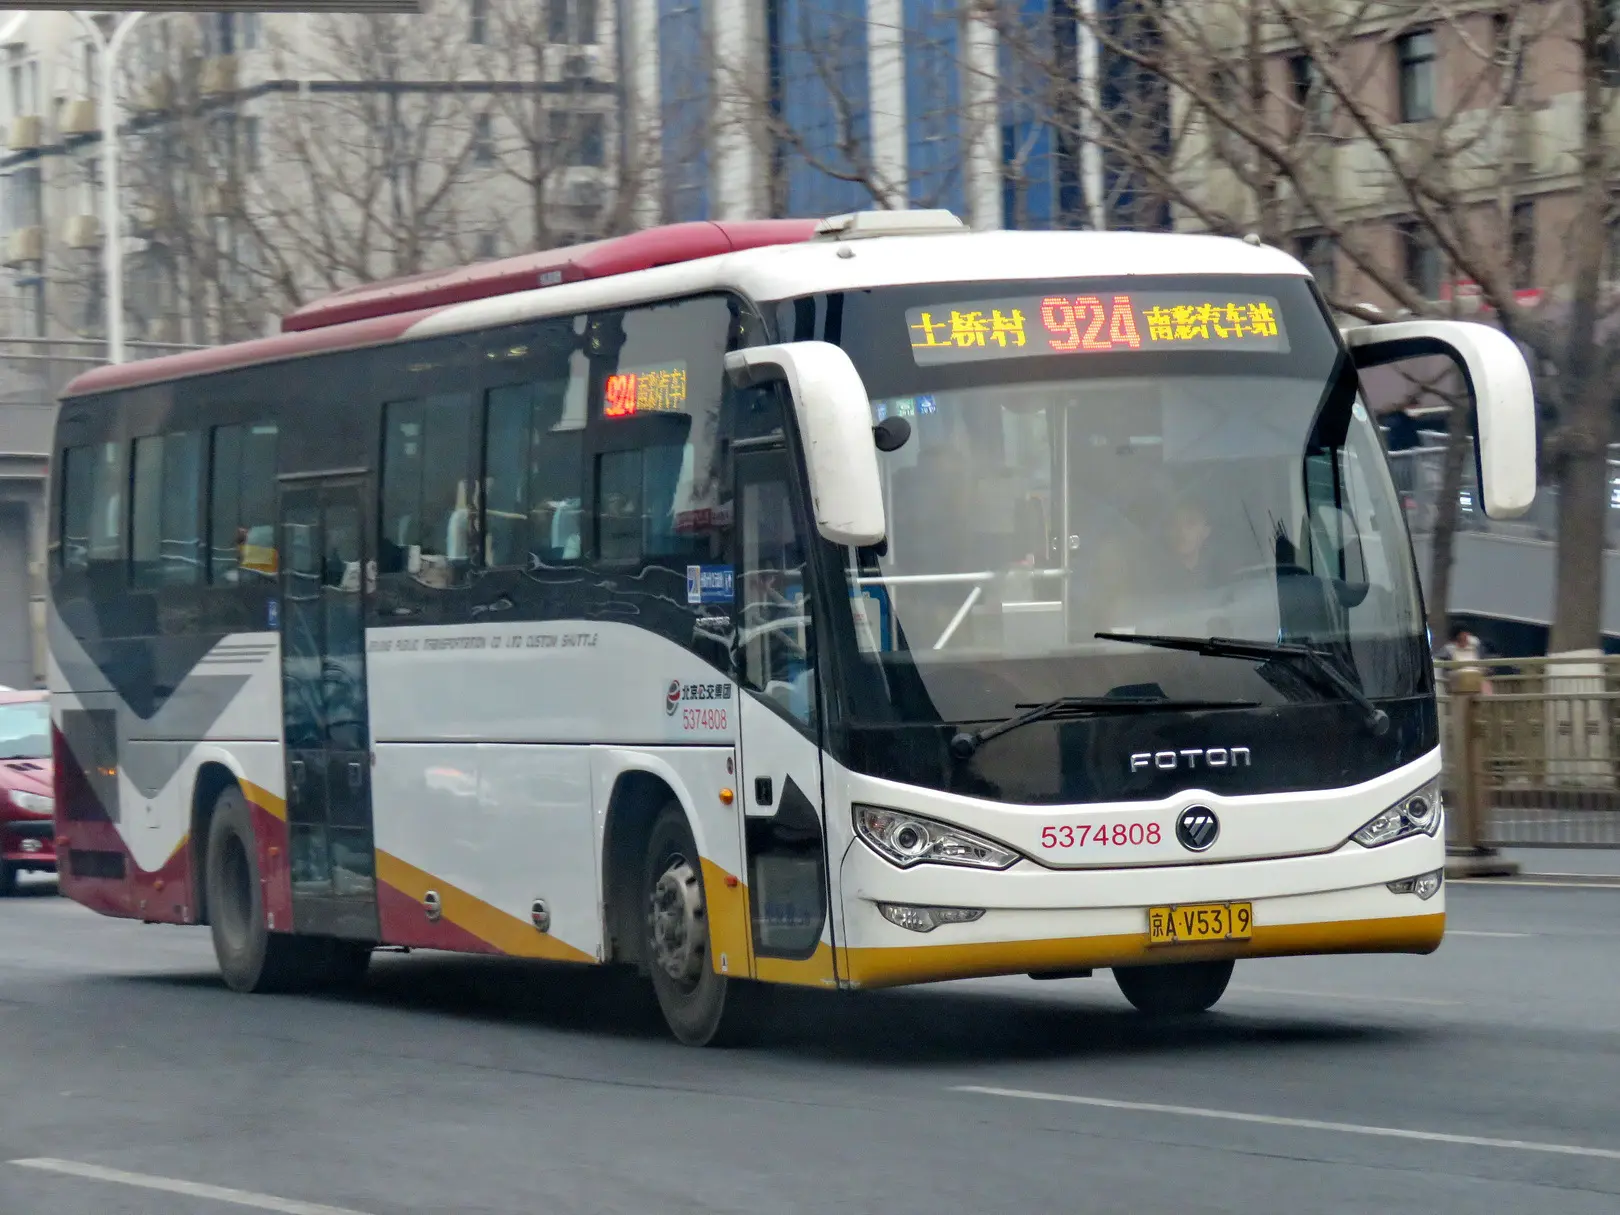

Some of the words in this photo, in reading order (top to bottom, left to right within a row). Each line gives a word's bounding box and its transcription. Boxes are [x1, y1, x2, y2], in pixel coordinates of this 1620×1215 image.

[911, 311, 1026, 347] 土桥村
[1041, 295, 1140, 350] 924
[605, 373, 637, 417] 924
[682, 684, 732, 700] 北京公交集团
[683, 708, 728, 730] 5374808
[1130, 747, 1251, 773] FOTON
[1041, 822, 1161, 848] 5374808
